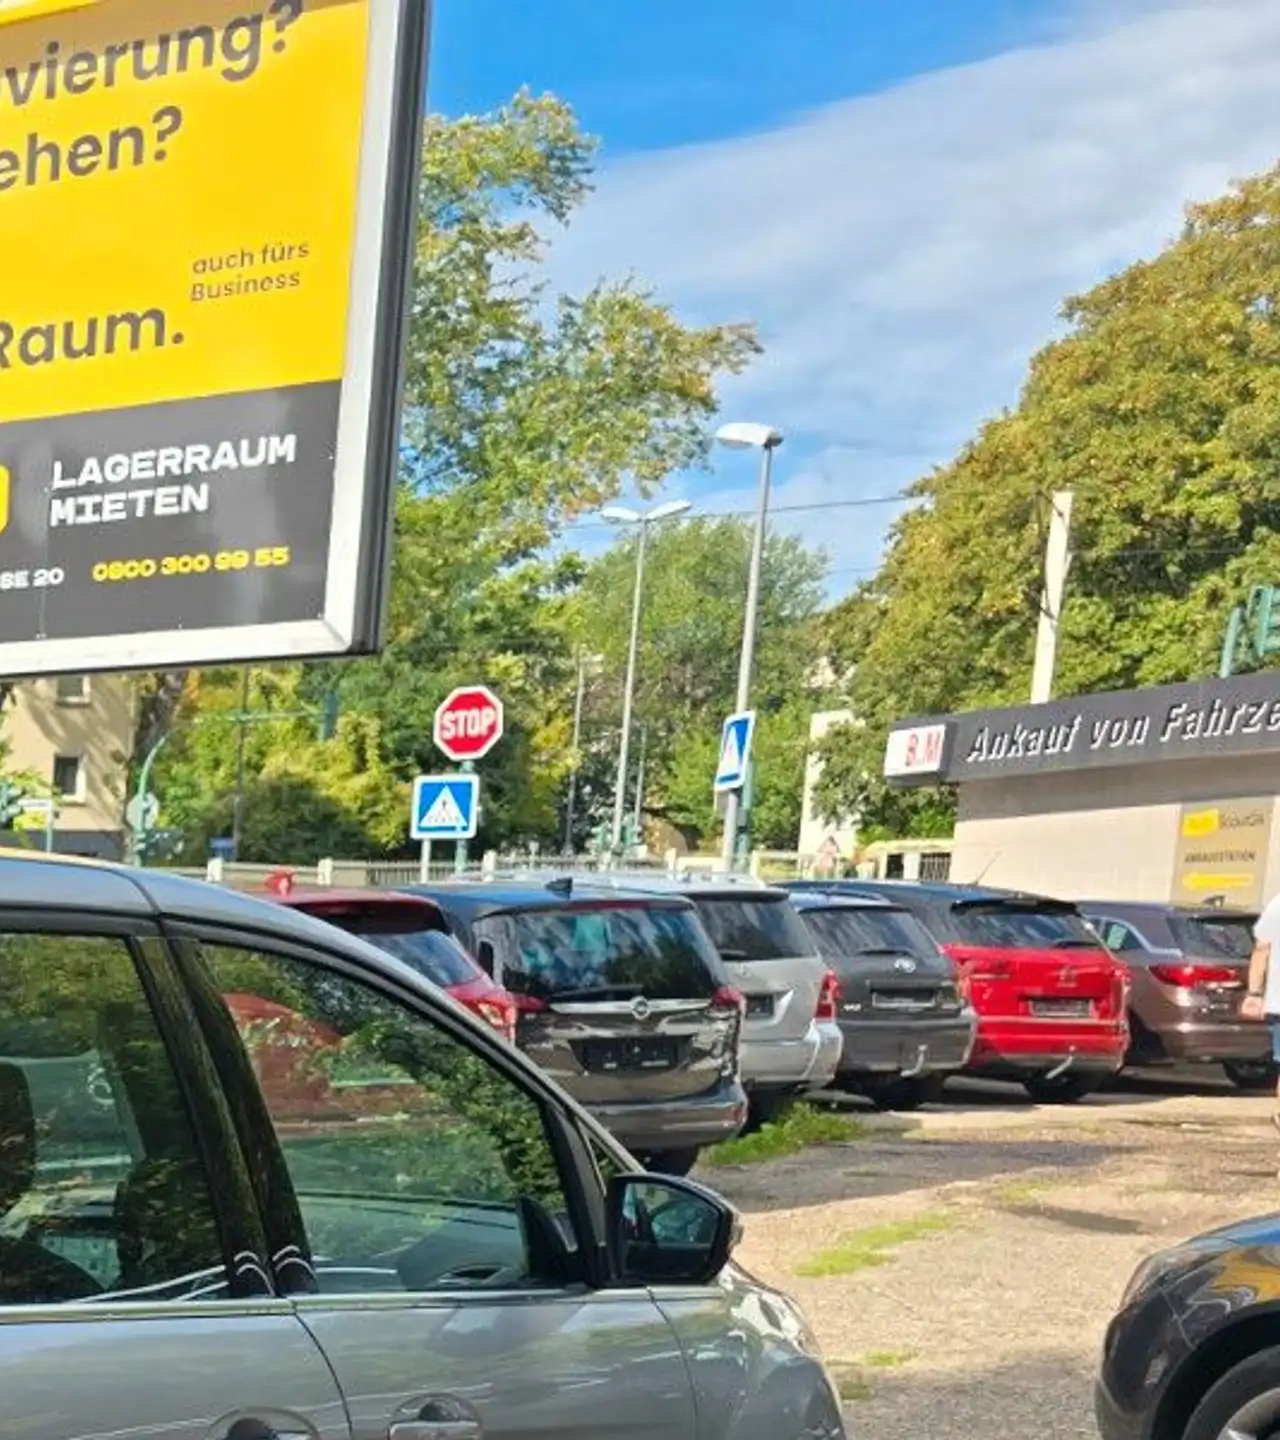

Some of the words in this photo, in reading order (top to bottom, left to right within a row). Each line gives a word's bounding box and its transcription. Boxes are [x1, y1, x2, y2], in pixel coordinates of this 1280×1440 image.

[192, 250, 255, 275] auch
[261, 240, 311, 266] fürs
[190, 270, 302, 302] Business
[51, 434, 298, 490] LAGERRAUM
[49, 484, 210, 528] MIETEN
[32, 567, 66, 588] 20
[160, 554, 211, 575] 300
[254, 546, 290, 567] 55
[442, 705, 496, 740] STOP
[966, 714, 1083, 763] Ankauf
[1090, 714, 1151, 750] von
